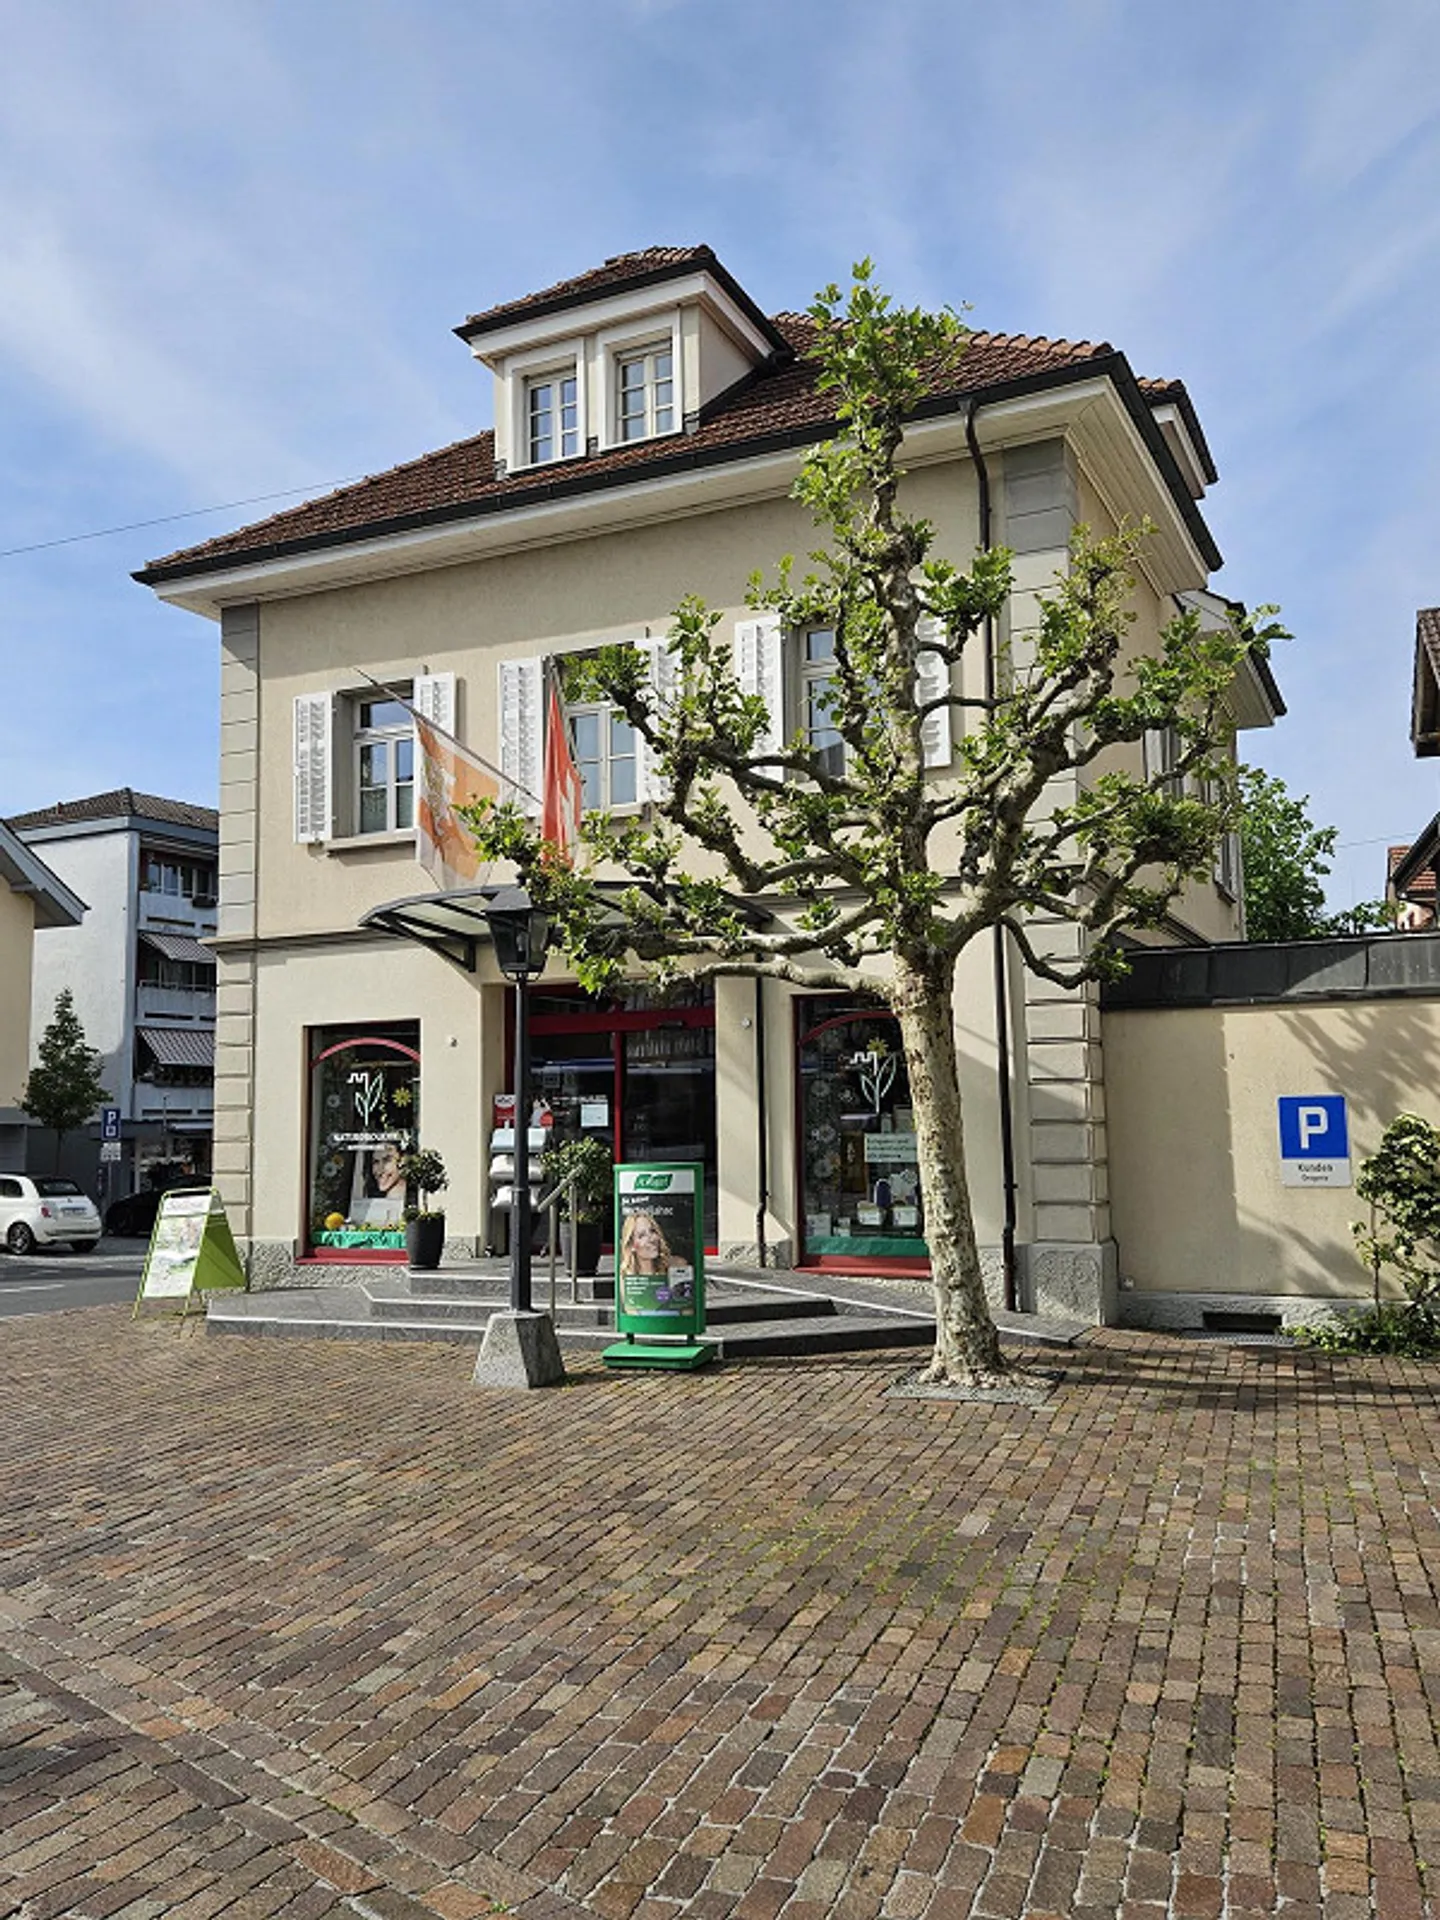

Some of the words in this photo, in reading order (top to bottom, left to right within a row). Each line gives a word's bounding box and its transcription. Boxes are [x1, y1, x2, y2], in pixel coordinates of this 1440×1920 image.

[108, 1111, 117, 1125] P
[1298, 1106, 1328, 1150] P
[1298, 1163, 1333, 1172] Kunden
